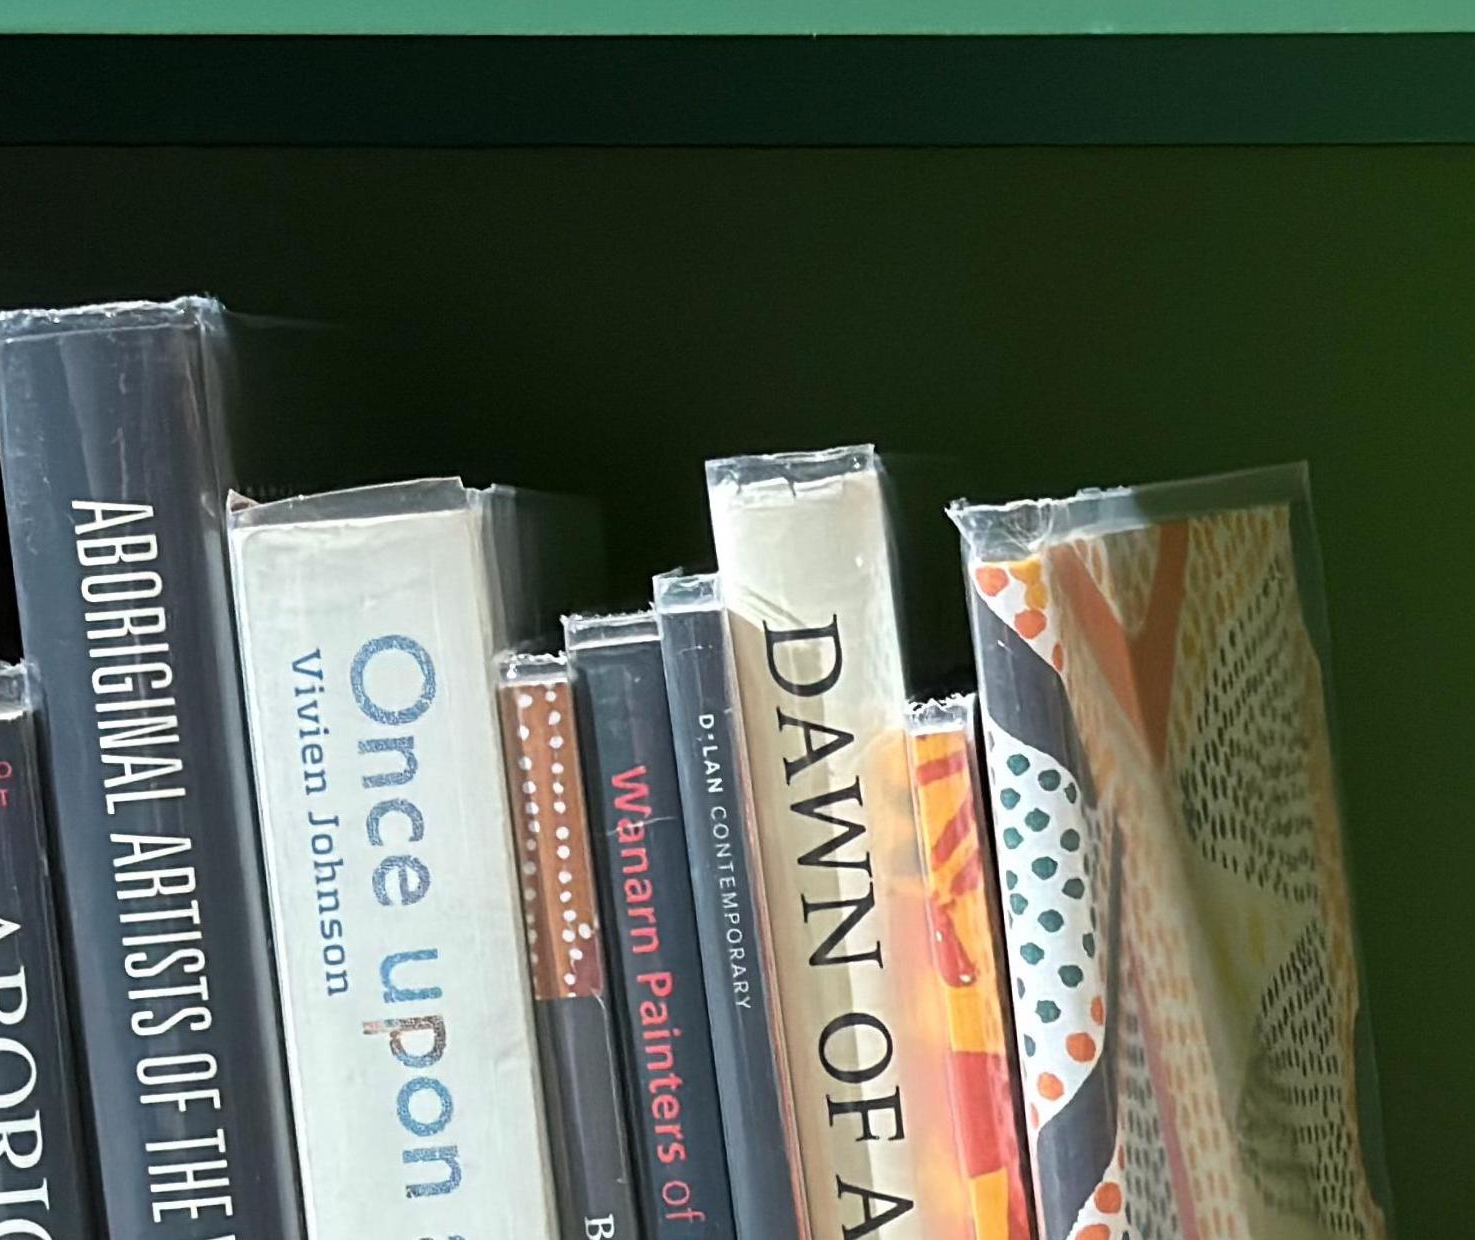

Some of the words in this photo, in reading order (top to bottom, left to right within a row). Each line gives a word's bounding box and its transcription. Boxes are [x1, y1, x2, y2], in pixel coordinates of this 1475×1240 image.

[72, 500, 186, 815] ABORIGINAL
[291, 647, 331, 796] Vivien
[350, 634, 436, 906] Once
[763, 614, 884, 970] DAWN
[110, 833, 212, 1037] ARTISTS
[309, 810, 349, 997] Johnson
[612, 765, 660, 954] Wanarn
[637, 971, 687, 1165] Painters
[662, 1180, 706, 1223] of
[711, 806, 751, 1009] CONTEMPORARY
[136, 1053, 221, 1112] OF
[362, 947, 462, 1199] upon
[819, 1012, 907, 1145] OF
[146, 1129, 234, 1223] THE
